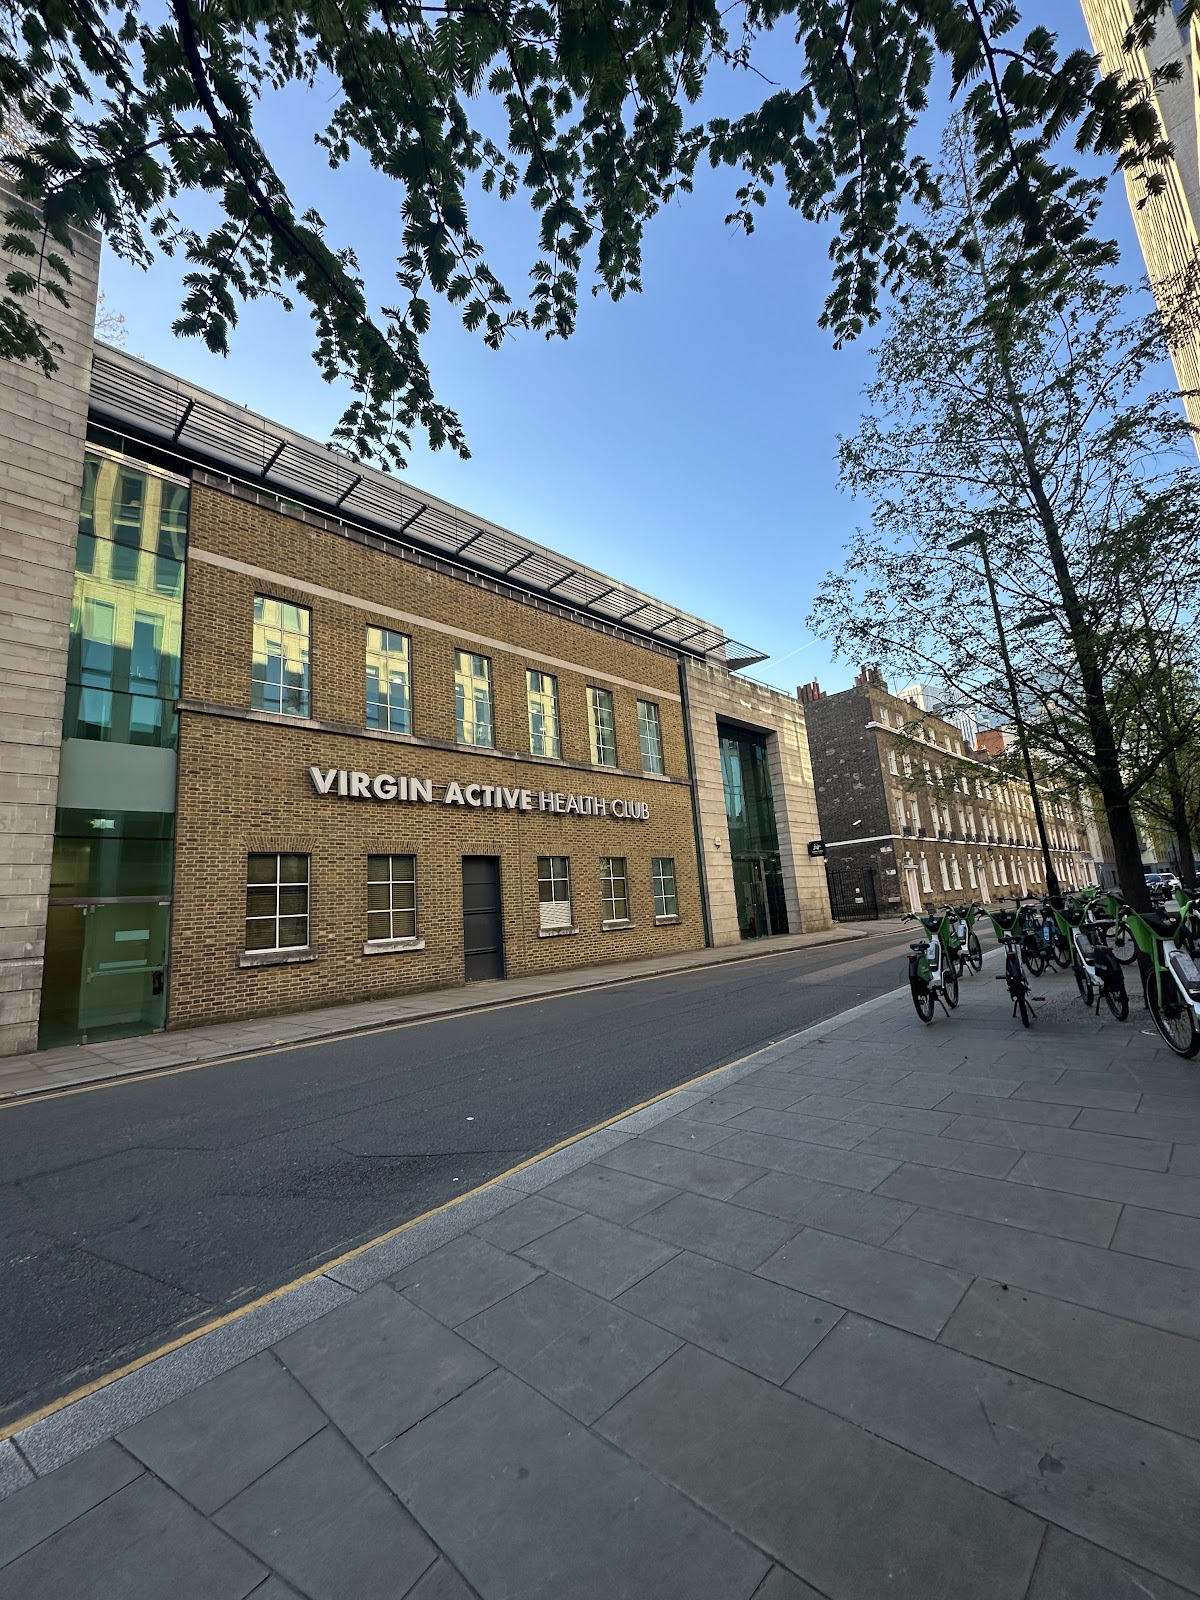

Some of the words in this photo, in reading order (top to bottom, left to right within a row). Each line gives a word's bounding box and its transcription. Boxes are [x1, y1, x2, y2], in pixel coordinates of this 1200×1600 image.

[309, 766, 432, 802] VIRGIN
[444, 781, 532, 810] ACTIVE
[539, 791, 606, 816] HEALTH
[610, 799, 650, 820] CLUB
